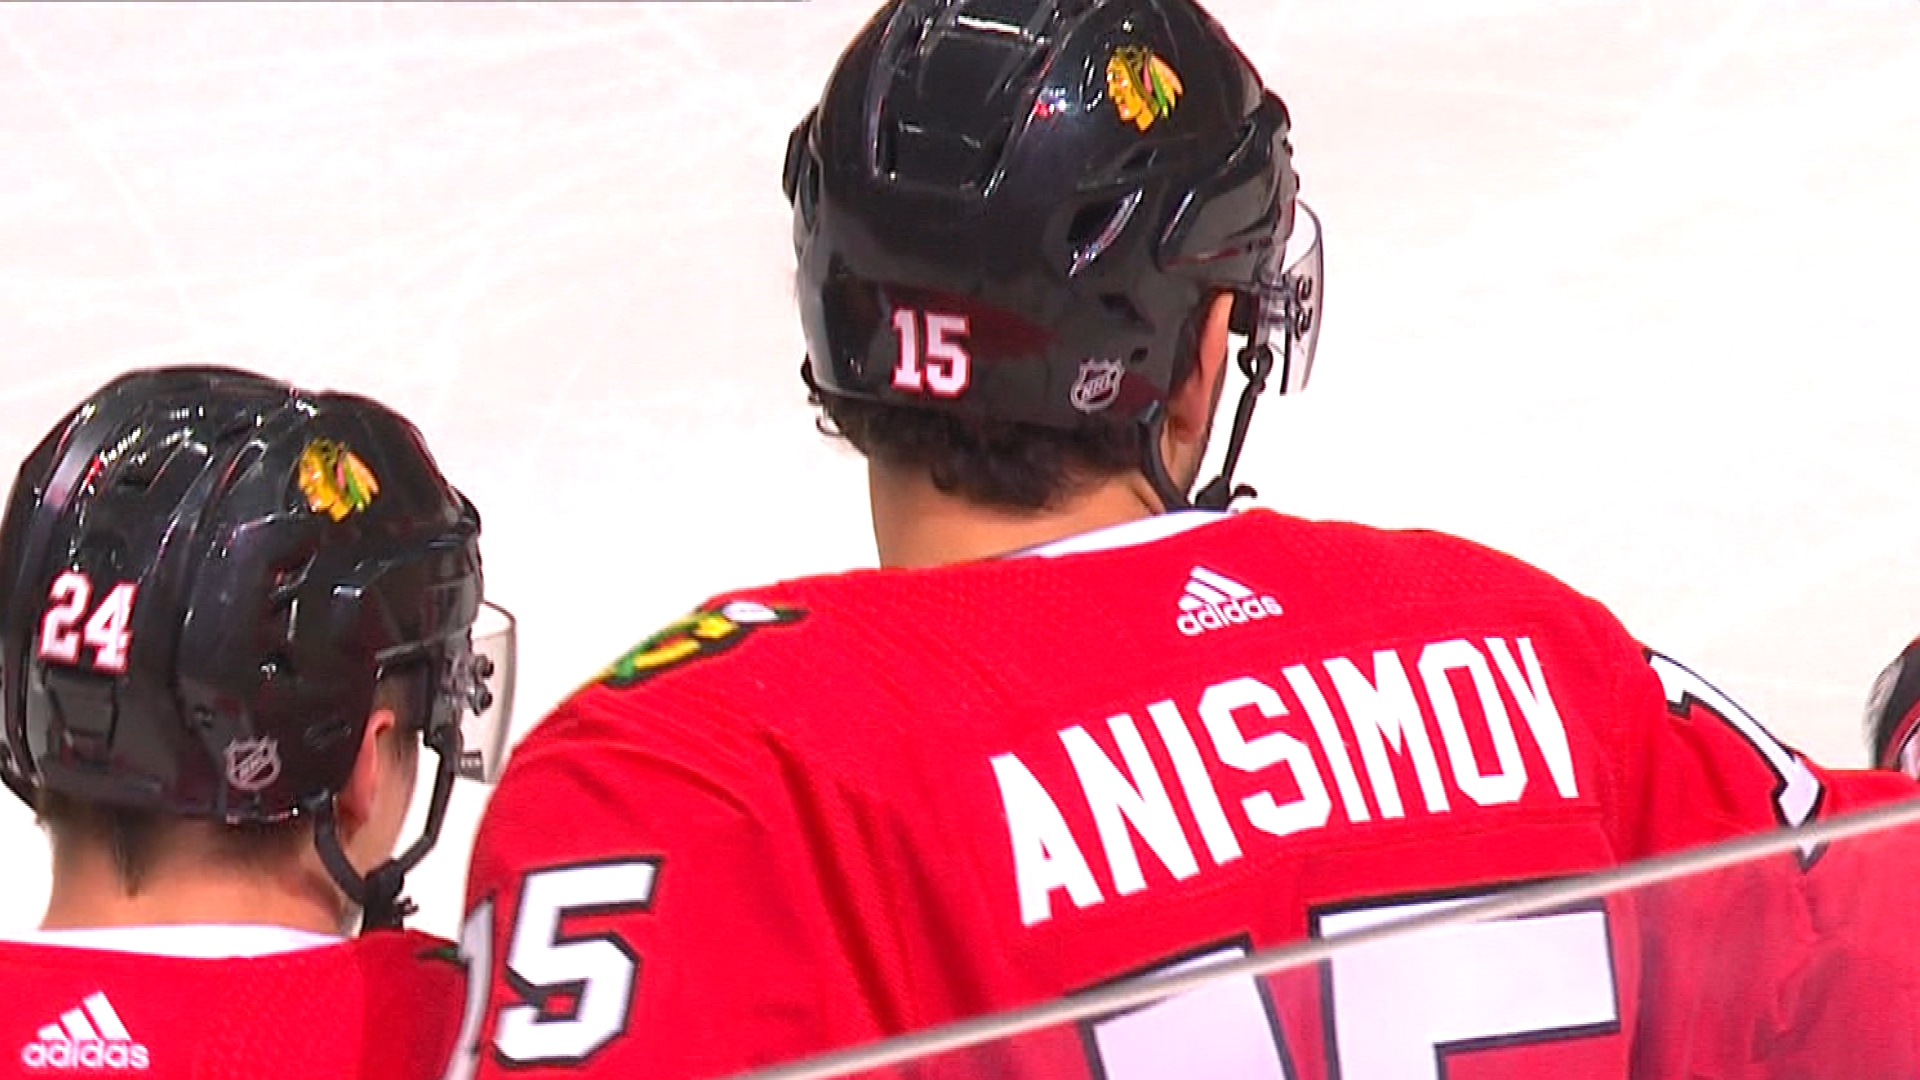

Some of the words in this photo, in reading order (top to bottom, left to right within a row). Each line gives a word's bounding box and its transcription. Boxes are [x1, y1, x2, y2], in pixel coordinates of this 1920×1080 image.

[891, 307, 972, 397] 15
[38, 569, 138, 673] 24
[1176, 595, 1284, 636] adidas
[988, 636, 1580, 927] ANISIMOV
[21, 1036, 150, 1070] adidas
